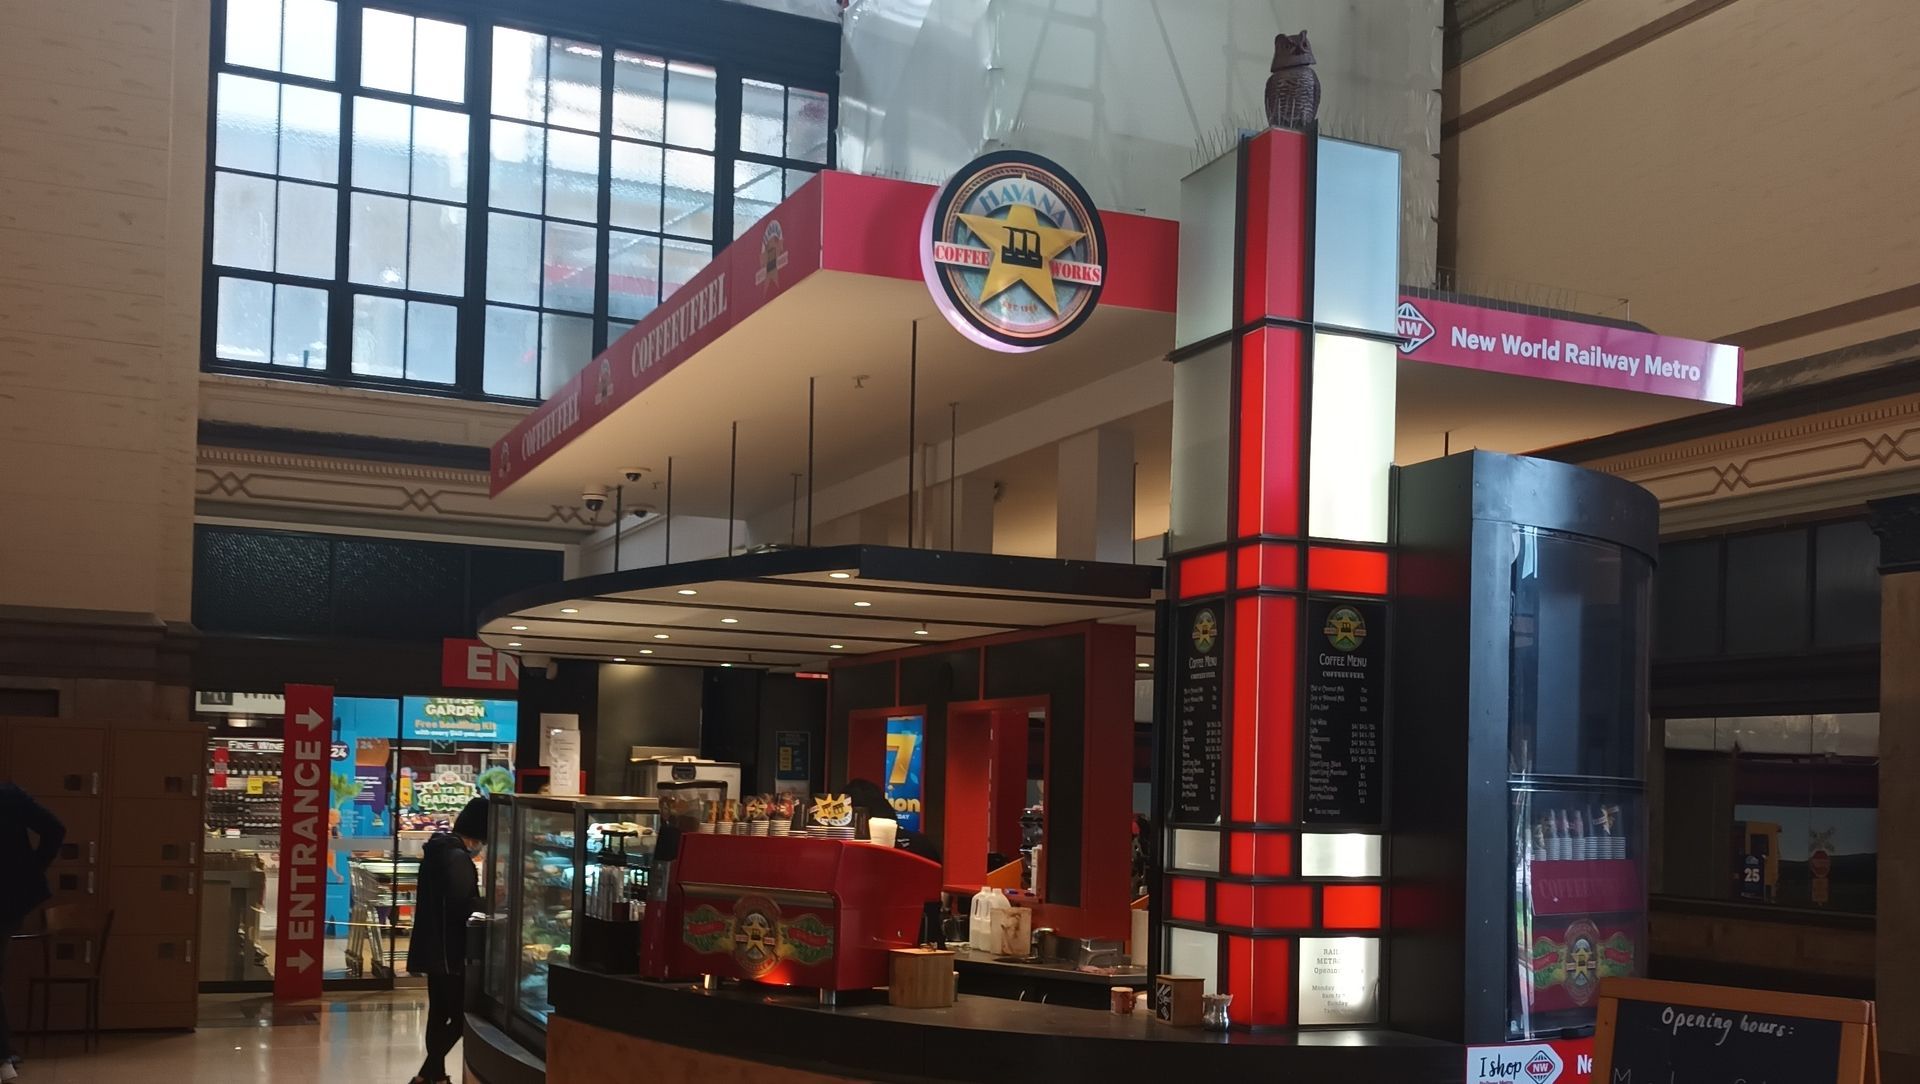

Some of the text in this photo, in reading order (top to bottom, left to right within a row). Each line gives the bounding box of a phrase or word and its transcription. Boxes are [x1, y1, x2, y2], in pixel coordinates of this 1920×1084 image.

[979, 182, 1067, 227] HAVANA
[935, 244, 1101, 283] COFFEE WORKS
[1451, 326, 1701, 382] New World Railway Metro
[467, 645, 519, 682] EN
[425, 704, 485, 718] GARDEN
[886, 733, 917, 784] 7
[288, 740, 322, 940] ENTRANCE
[1743, 867, 1761, 883] 25
[1661, 1006, 1795, 1046] Opening hours:
[1479, 1053, 1522, 1080] I shop
[1532, 1062, 1549, 1074] NW
